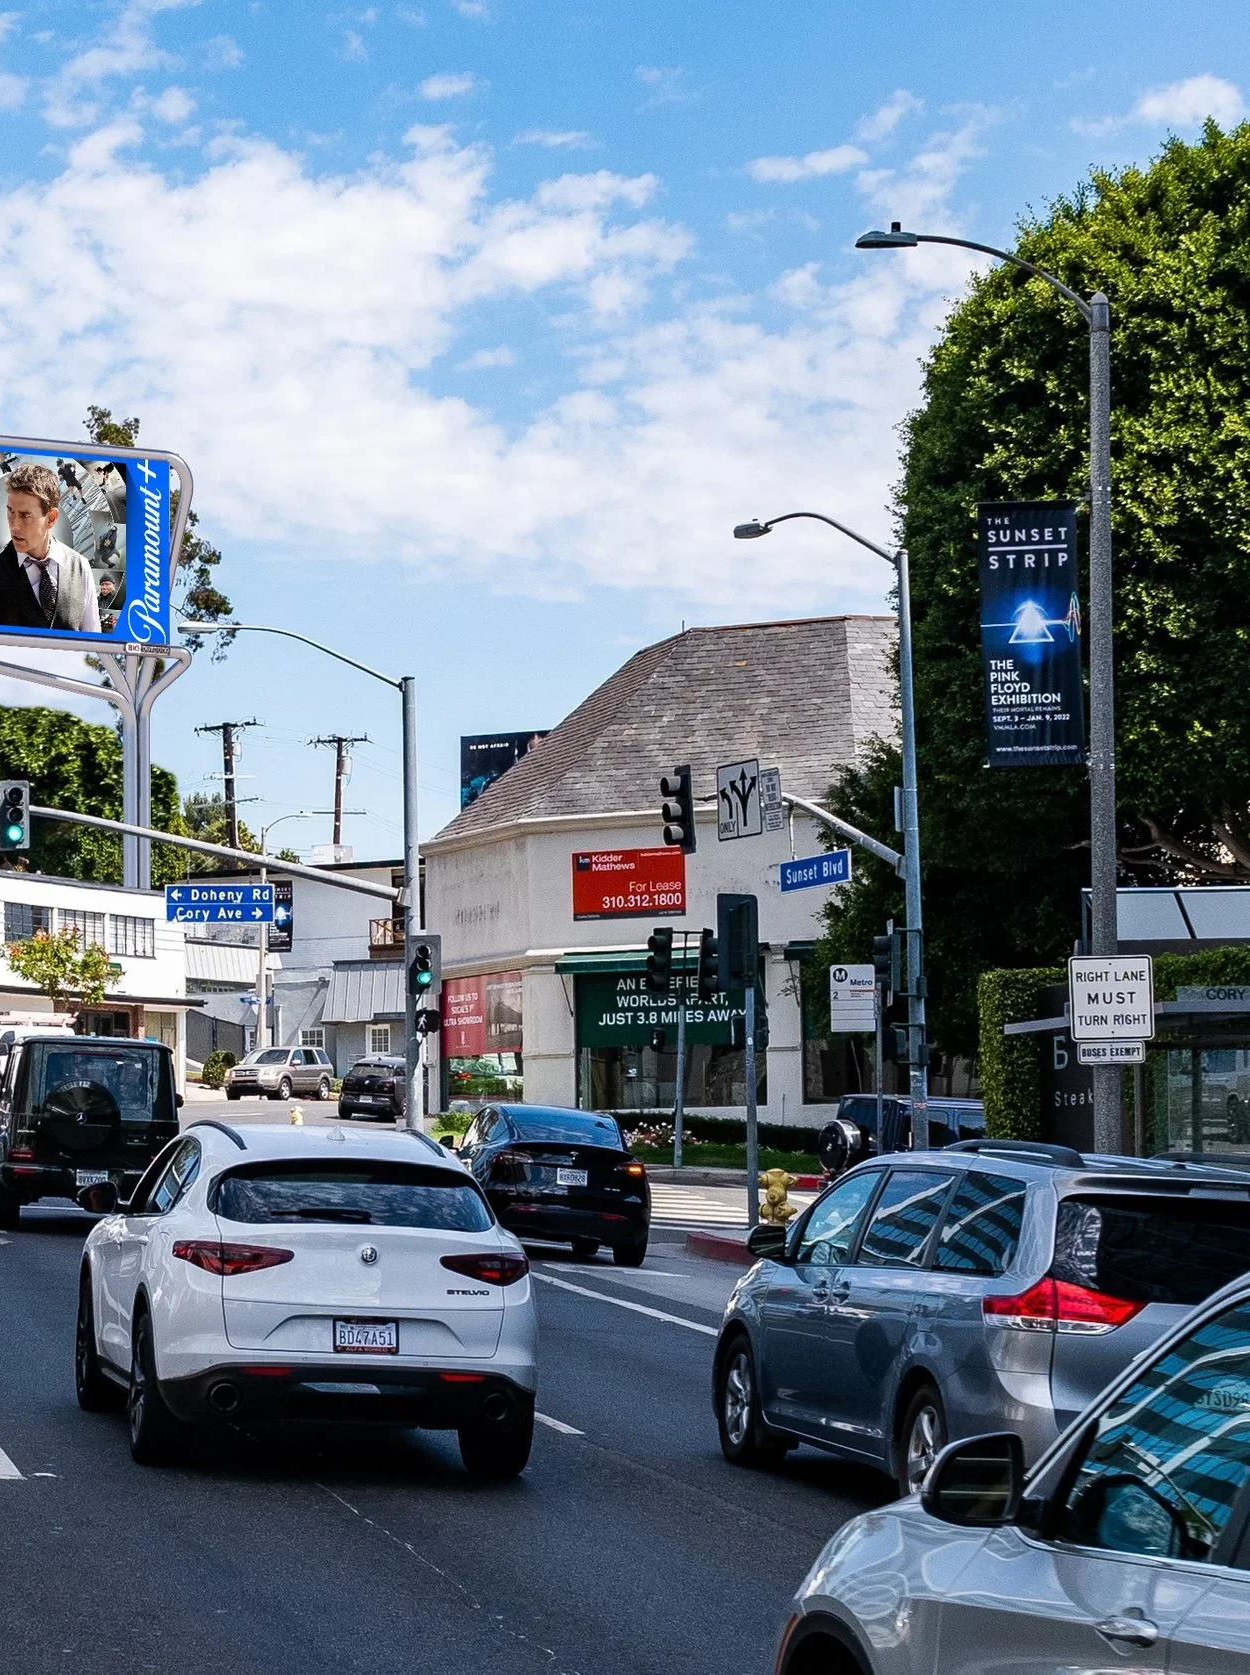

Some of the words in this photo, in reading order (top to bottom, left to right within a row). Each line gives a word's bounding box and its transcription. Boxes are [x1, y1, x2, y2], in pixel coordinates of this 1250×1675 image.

[987, 517, 1010, 525] THE
[987, 527, 1067, 543] SUNSET
[989, 552, 1068, 570] STRIP
[990, 659, 1014, 670] THE
[990, 671, 1020, 682] PINK
[991, 682, 1031, 694] FLOYD
[991, 692, 1061, 706] EXHIBITION
[993, 715, 1013, 723] SEPT.
[720, 820, 736, 834] ONLY
[592, 855, 623, 863] Kidder
[592, 862, 635, 871] Mathews
[786, 865, 817, 885] Sunset
[822, 859, 843, 877] Blvd
[630, 881, 647, 892] For
[650, 880, 682, 892] Lease
[191, 888, 243, 902] Doheny
[253, 888, 270, 900] Rd
[602, 893, 682, 909] 310.312.1800
[176, 907, 210, 921] Cory
[217, 907, 242, 919] Ave
[1076, 972, 1110, 982] RIGHT
[1114, 970, 1146, 982] LANE
[617, 978, 636, 991] AN
[833, 991, 839, 1000] 2
[1087, 992, 1136, 1005] MUST
[1206, 988, 1246, 1001] CORY
[599, 1012, 634, 1026] JUST
[636, 1012, 657, 1024] 3.8
[1077, 1015, 1108, 1026] TURN
[1113, 1014, 1147, 1026] RIGHT
[1082, 1048, 1107, 1057] BUSES
[1110, 1047, 1141, 1056] EXEMPT
[340, 1330, 393, 1346] BD47A51
